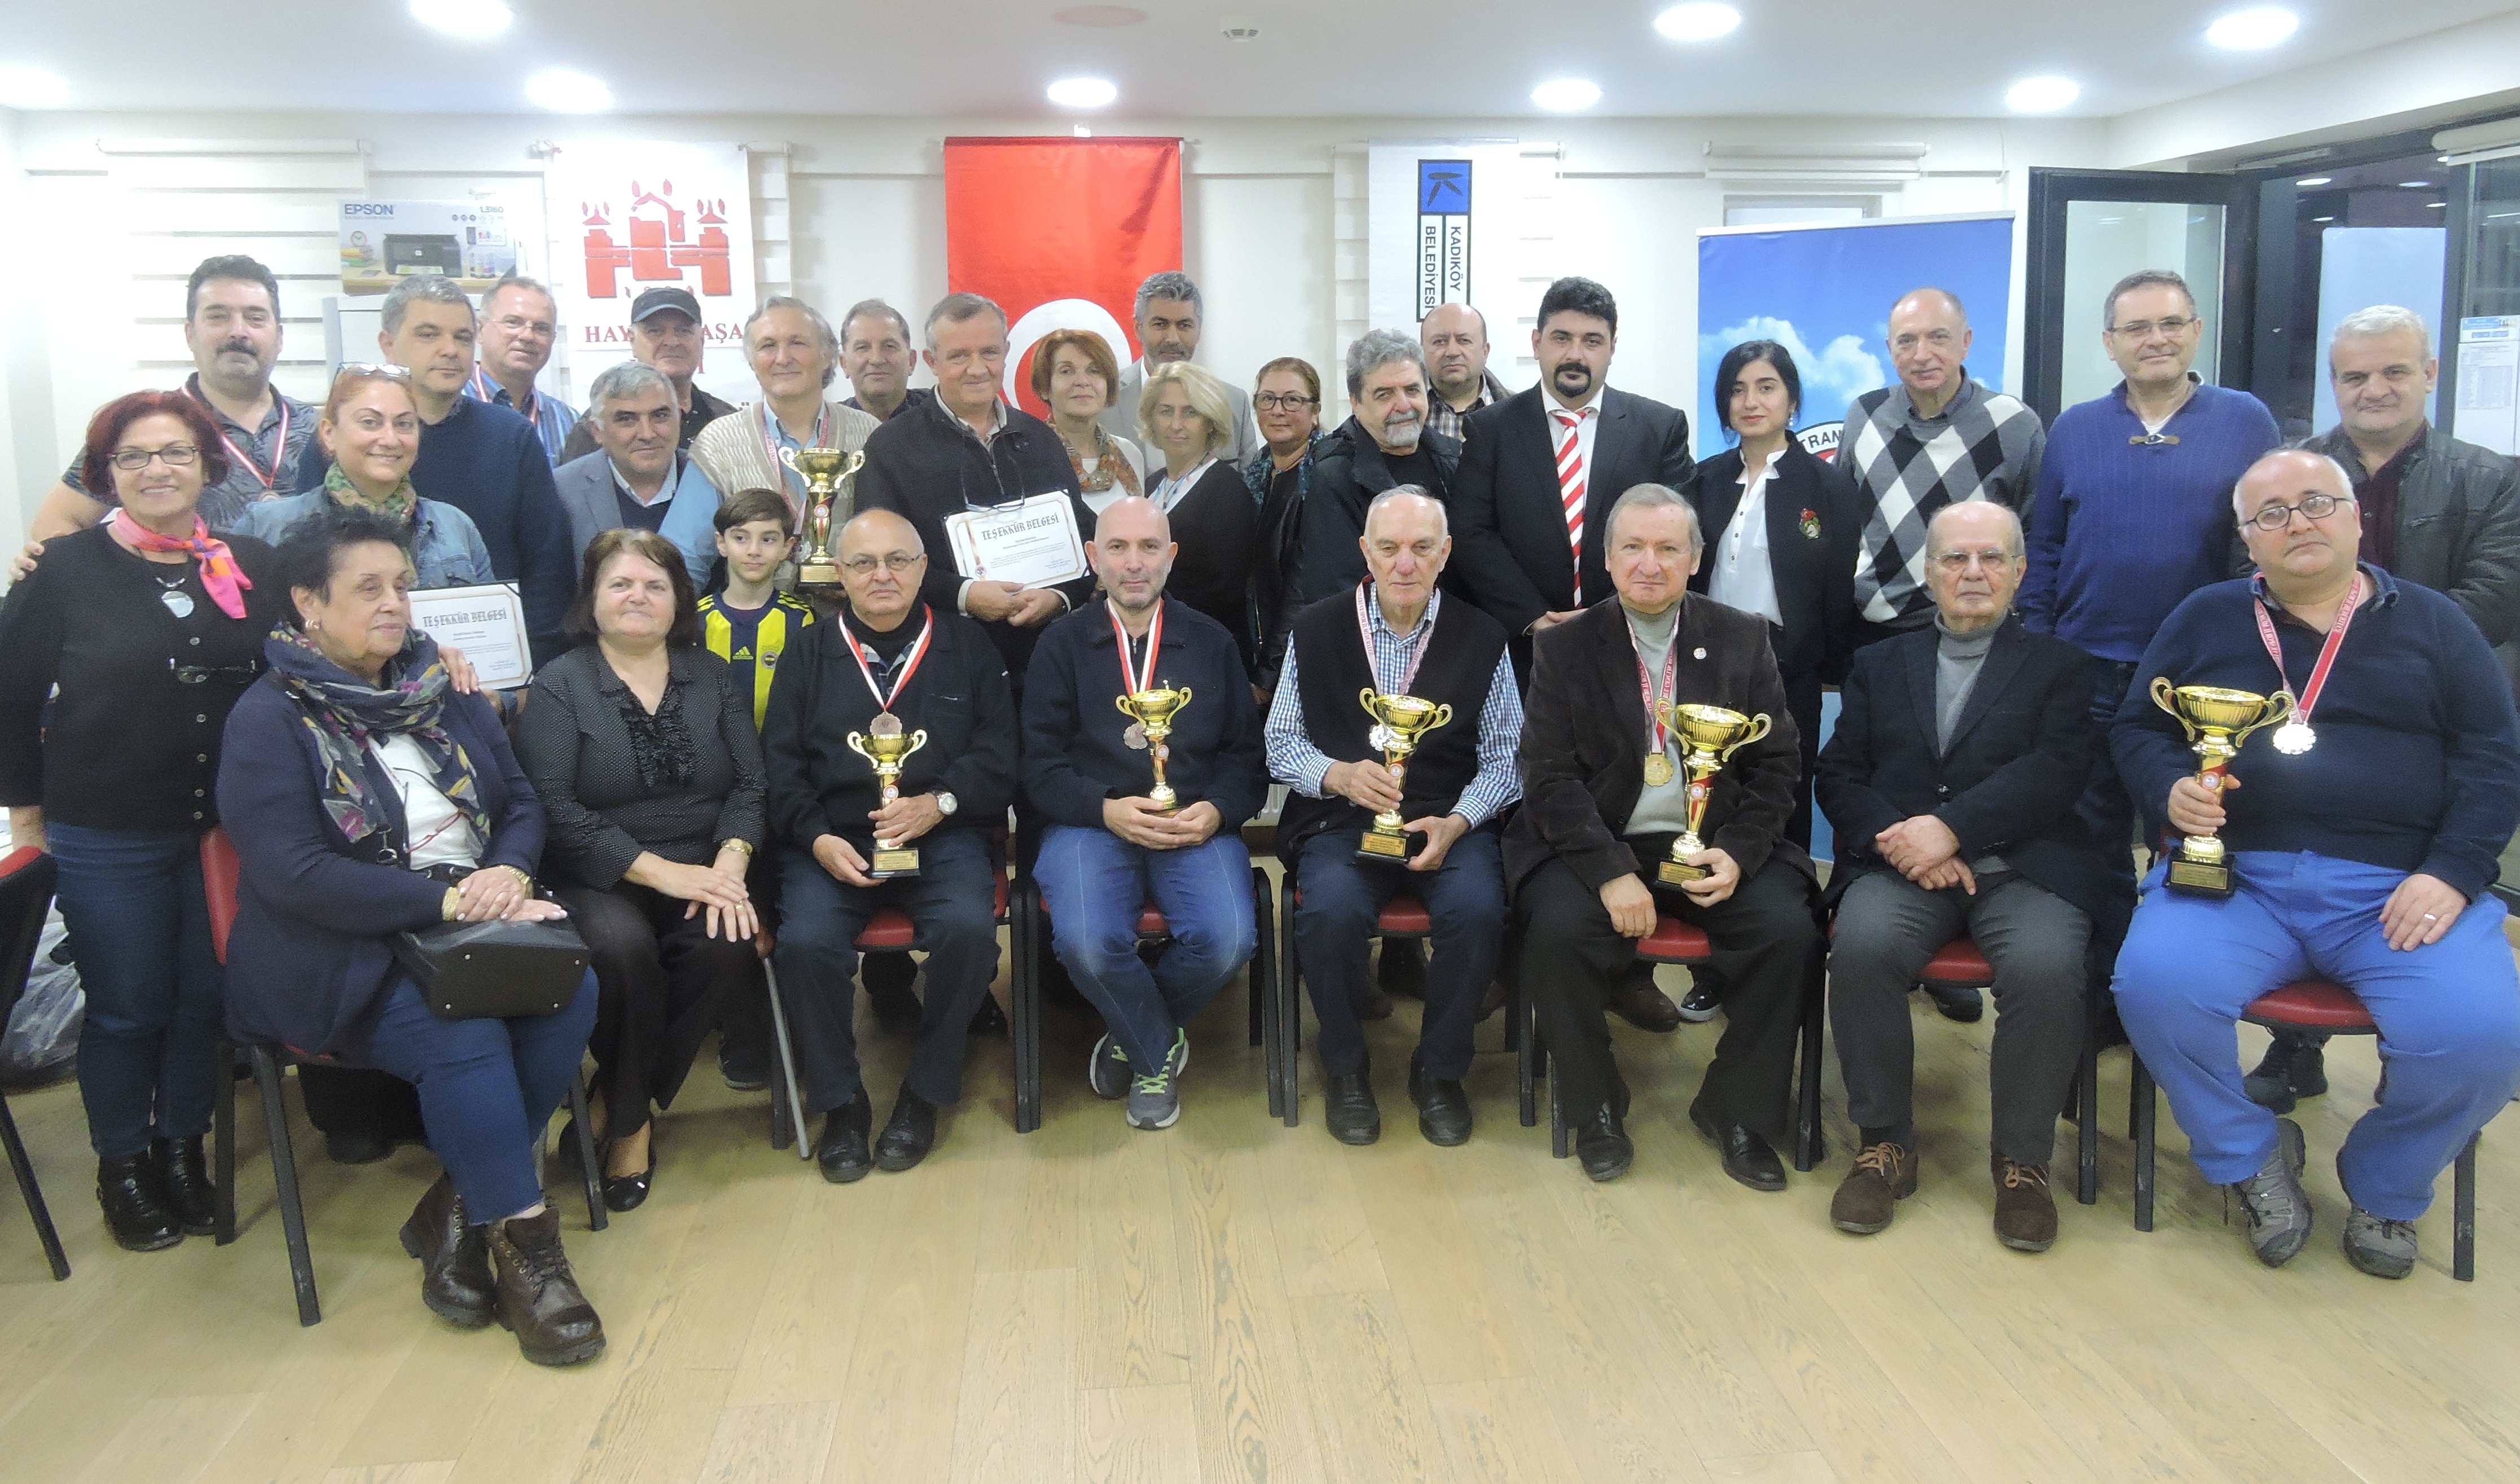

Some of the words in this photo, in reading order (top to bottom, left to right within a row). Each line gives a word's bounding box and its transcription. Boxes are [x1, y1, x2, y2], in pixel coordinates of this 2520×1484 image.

[344, 204, 394, 215] EPSON
[1450, 226, 1464, 291] KADIKÖY
[585, 323, 744, 344] HAYAŞA
[981, 521, 1026, 540] TEŞEKKÜR
[1026, 512, 1059, 530] BELGESİ
